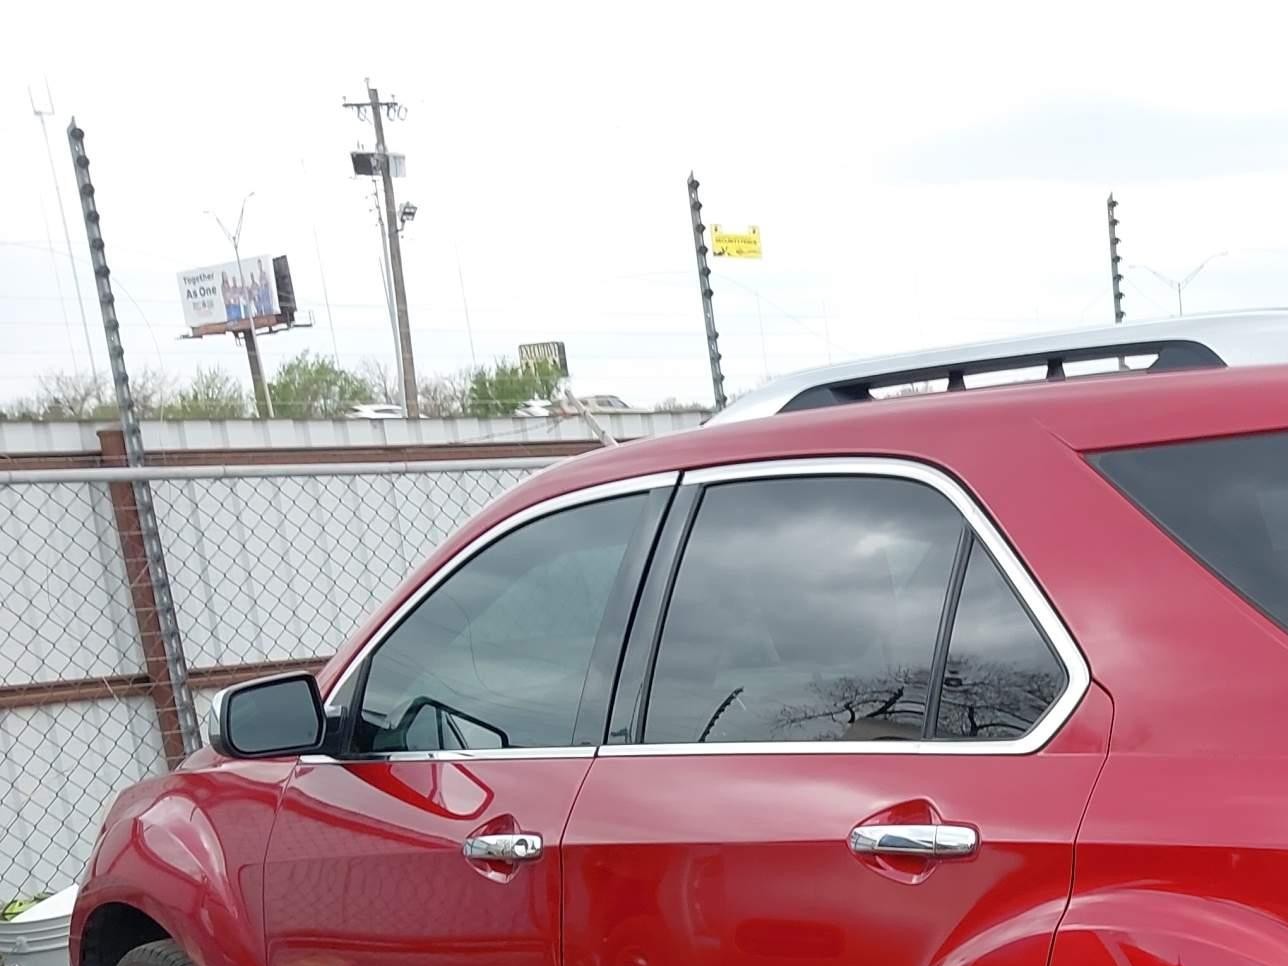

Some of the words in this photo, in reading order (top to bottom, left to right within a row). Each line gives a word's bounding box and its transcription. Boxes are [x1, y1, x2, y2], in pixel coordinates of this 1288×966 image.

[183, 273, 215, 285] Together
[186, 289, 198, 299] As
[199, 286, 217, 297] One
